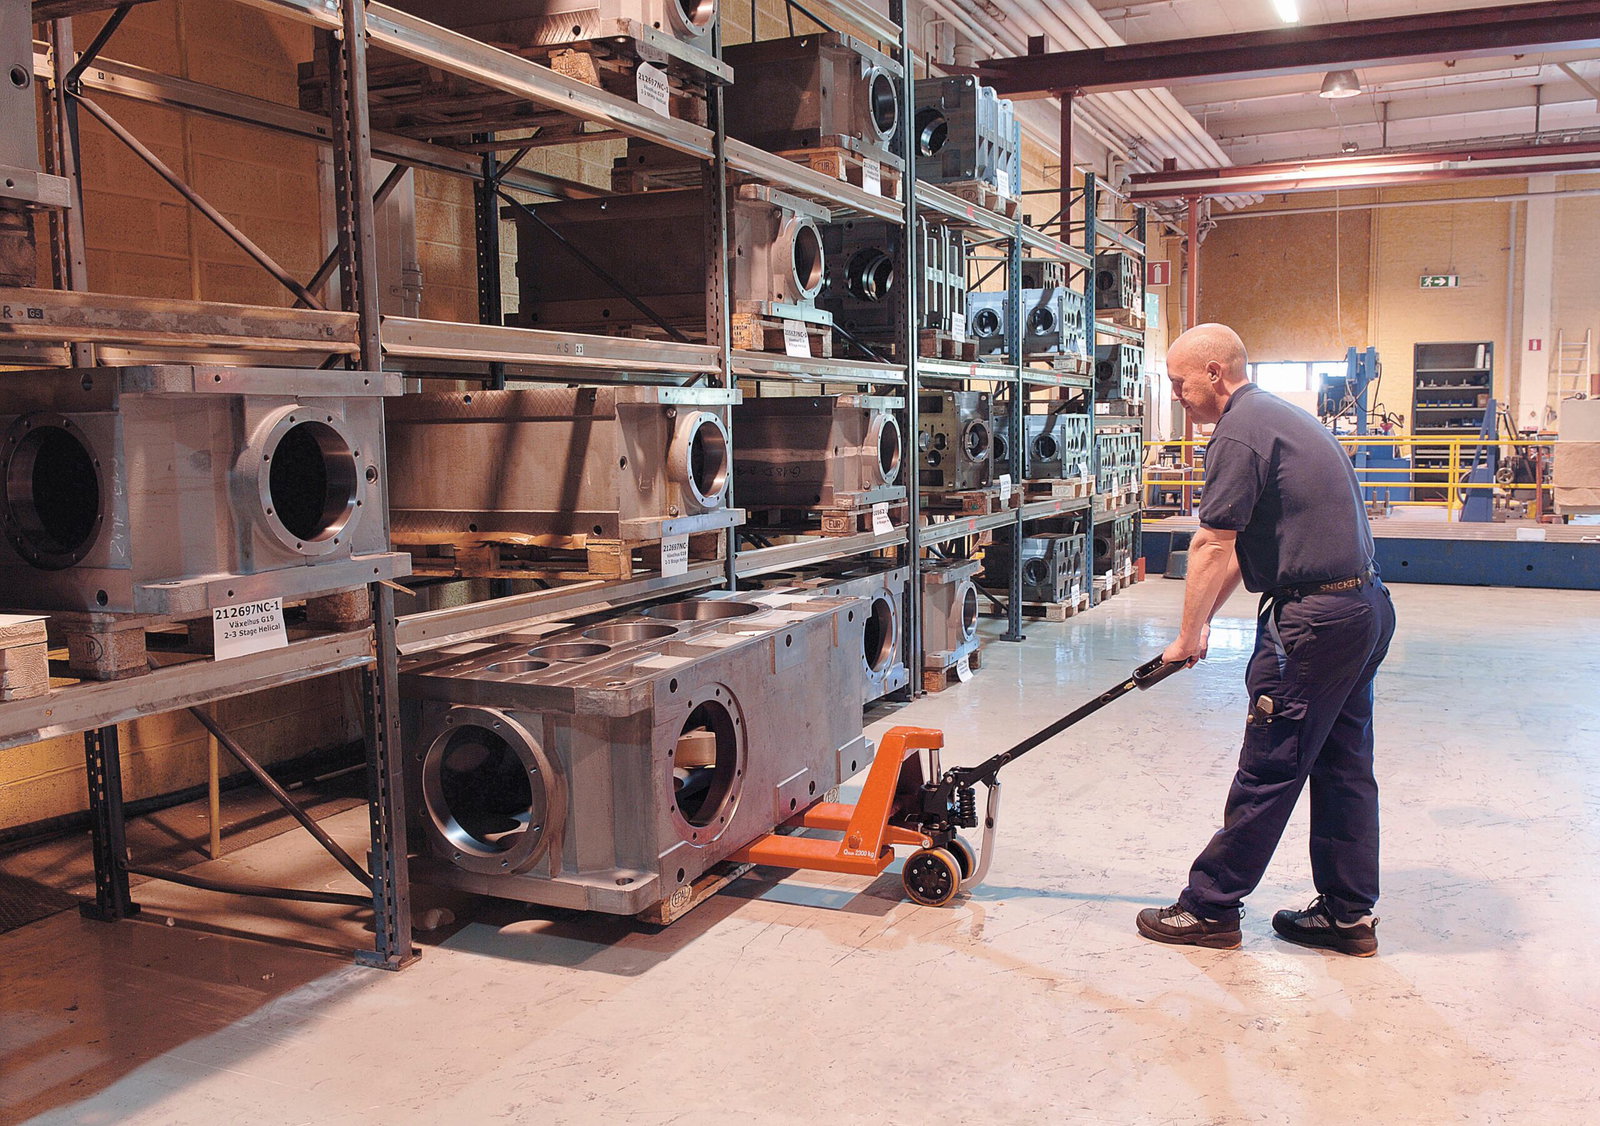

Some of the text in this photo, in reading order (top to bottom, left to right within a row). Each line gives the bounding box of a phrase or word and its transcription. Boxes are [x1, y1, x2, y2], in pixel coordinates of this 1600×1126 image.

[215, 601, 280, 620] 212697NC-1
[229, 615, 275, 628] Växelhus G19
[224, 623, 281, 639] 2-3 Stage Helical
